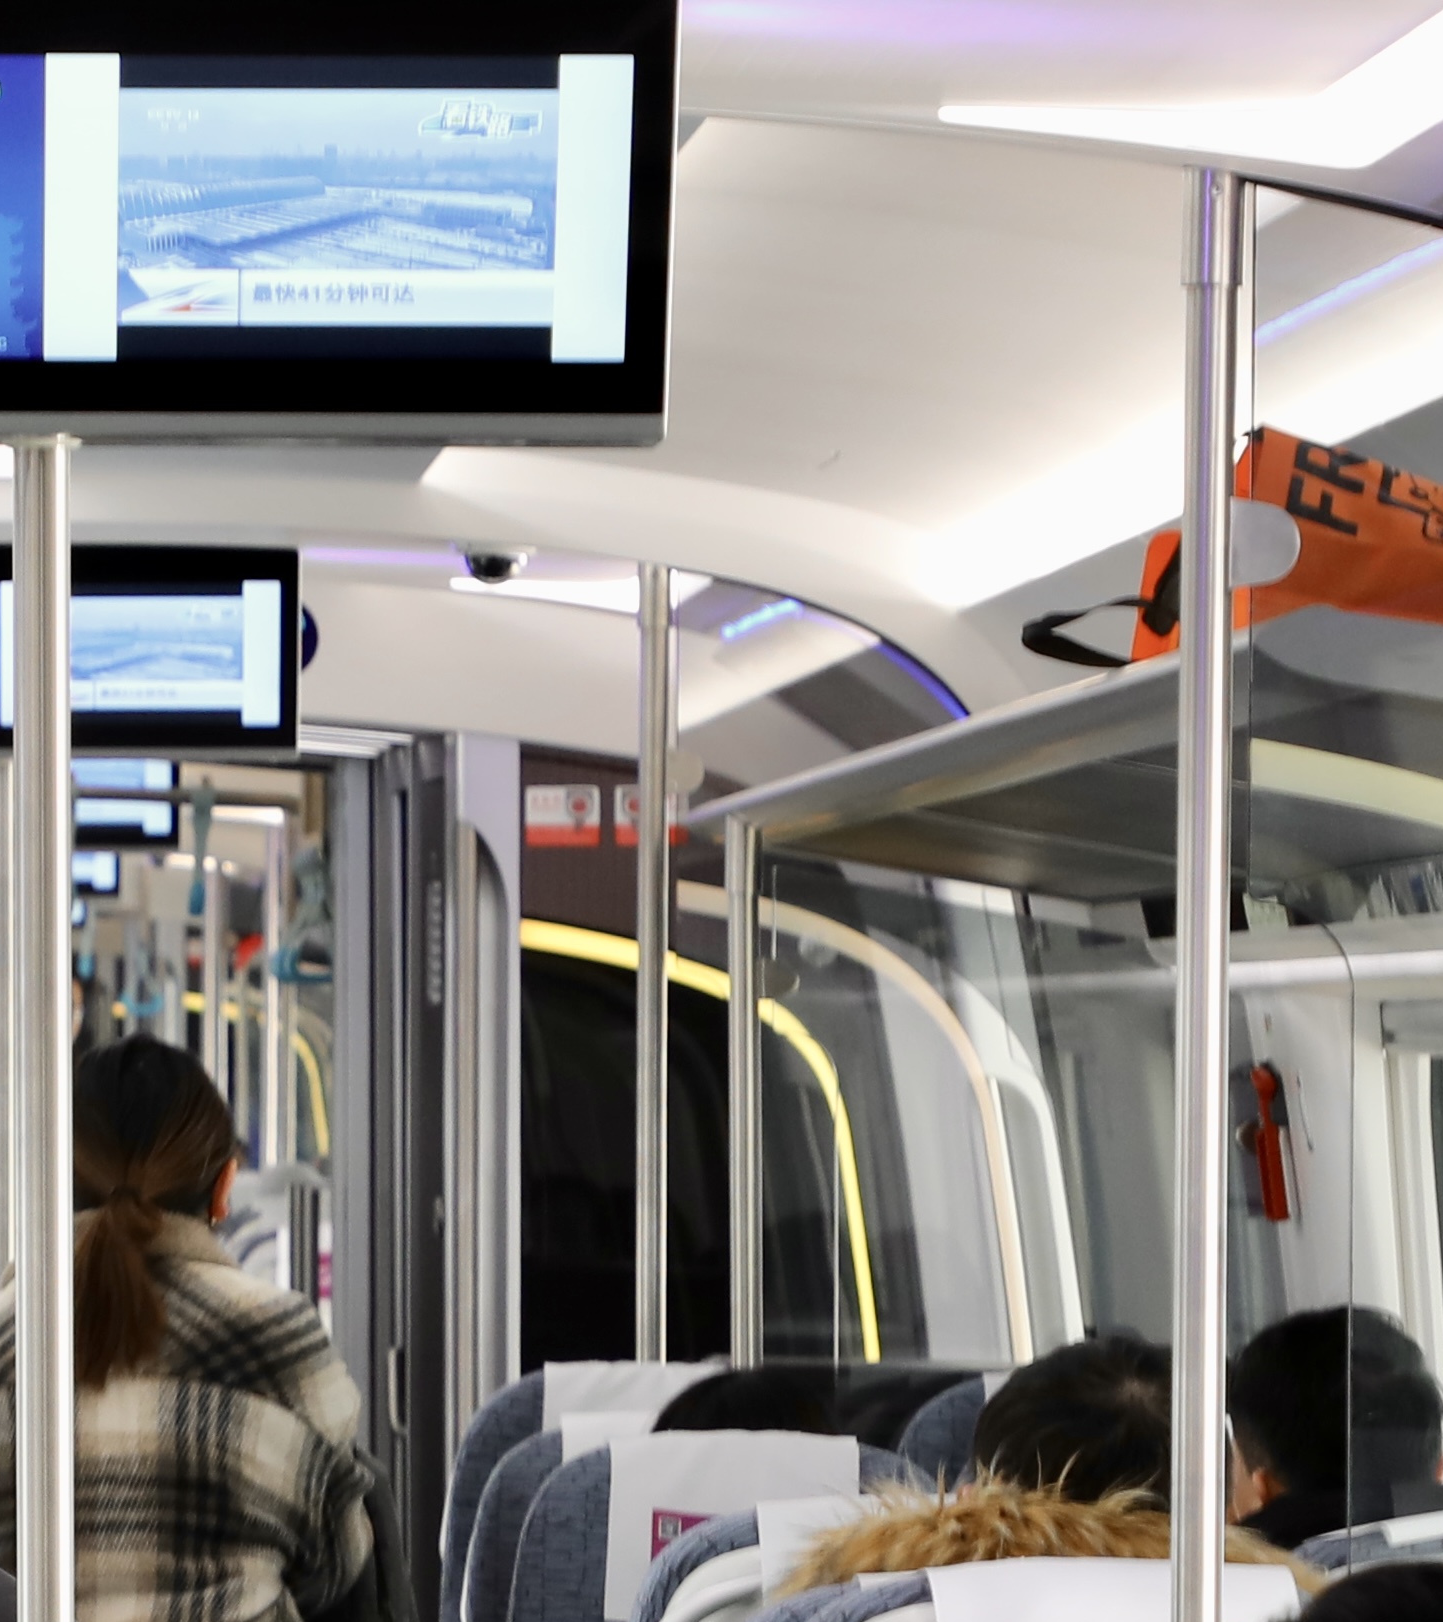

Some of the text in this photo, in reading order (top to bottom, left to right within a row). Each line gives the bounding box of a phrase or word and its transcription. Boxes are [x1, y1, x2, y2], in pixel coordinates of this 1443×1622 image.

[252, 282, 415, 304] 最快41分钟可达
